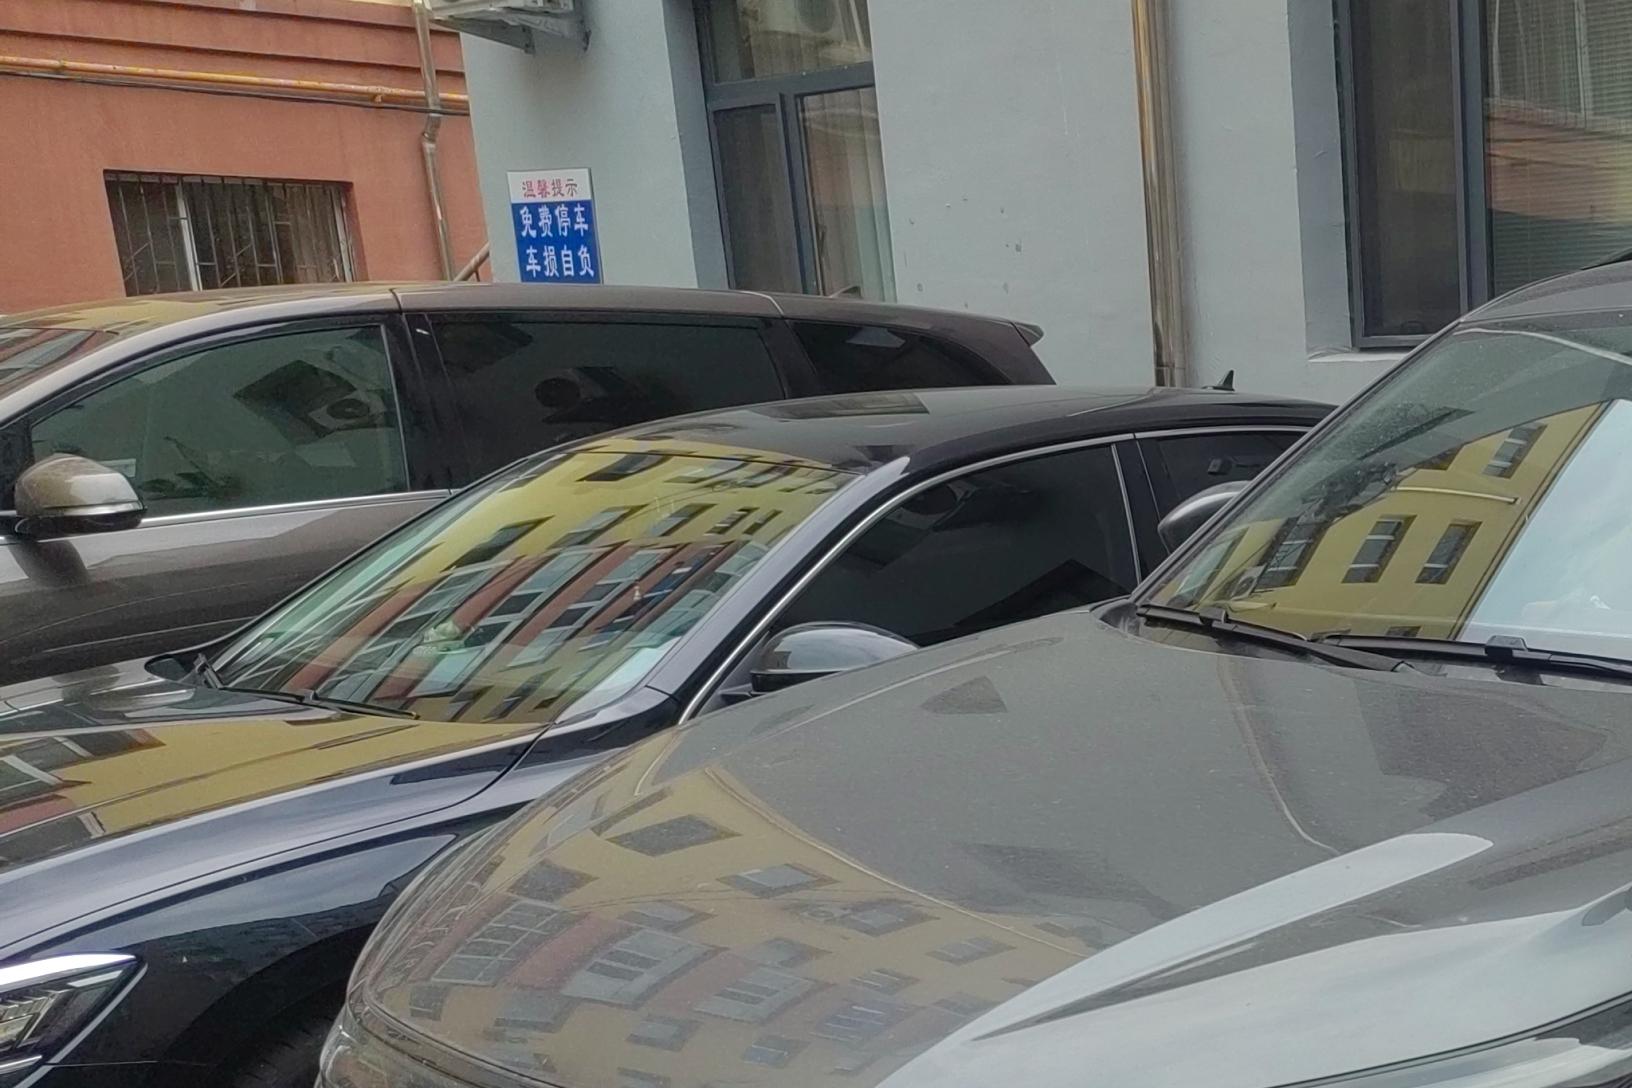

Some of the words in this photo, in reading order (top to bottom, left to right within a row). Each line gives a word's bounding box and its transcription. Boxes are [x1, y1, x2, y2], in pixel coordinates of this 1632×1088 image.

[521, 178, 578, 199] 温馨提示
[519, 203, 589, 238] 免费停车
[525, 244, 595, 278] 车损自负
